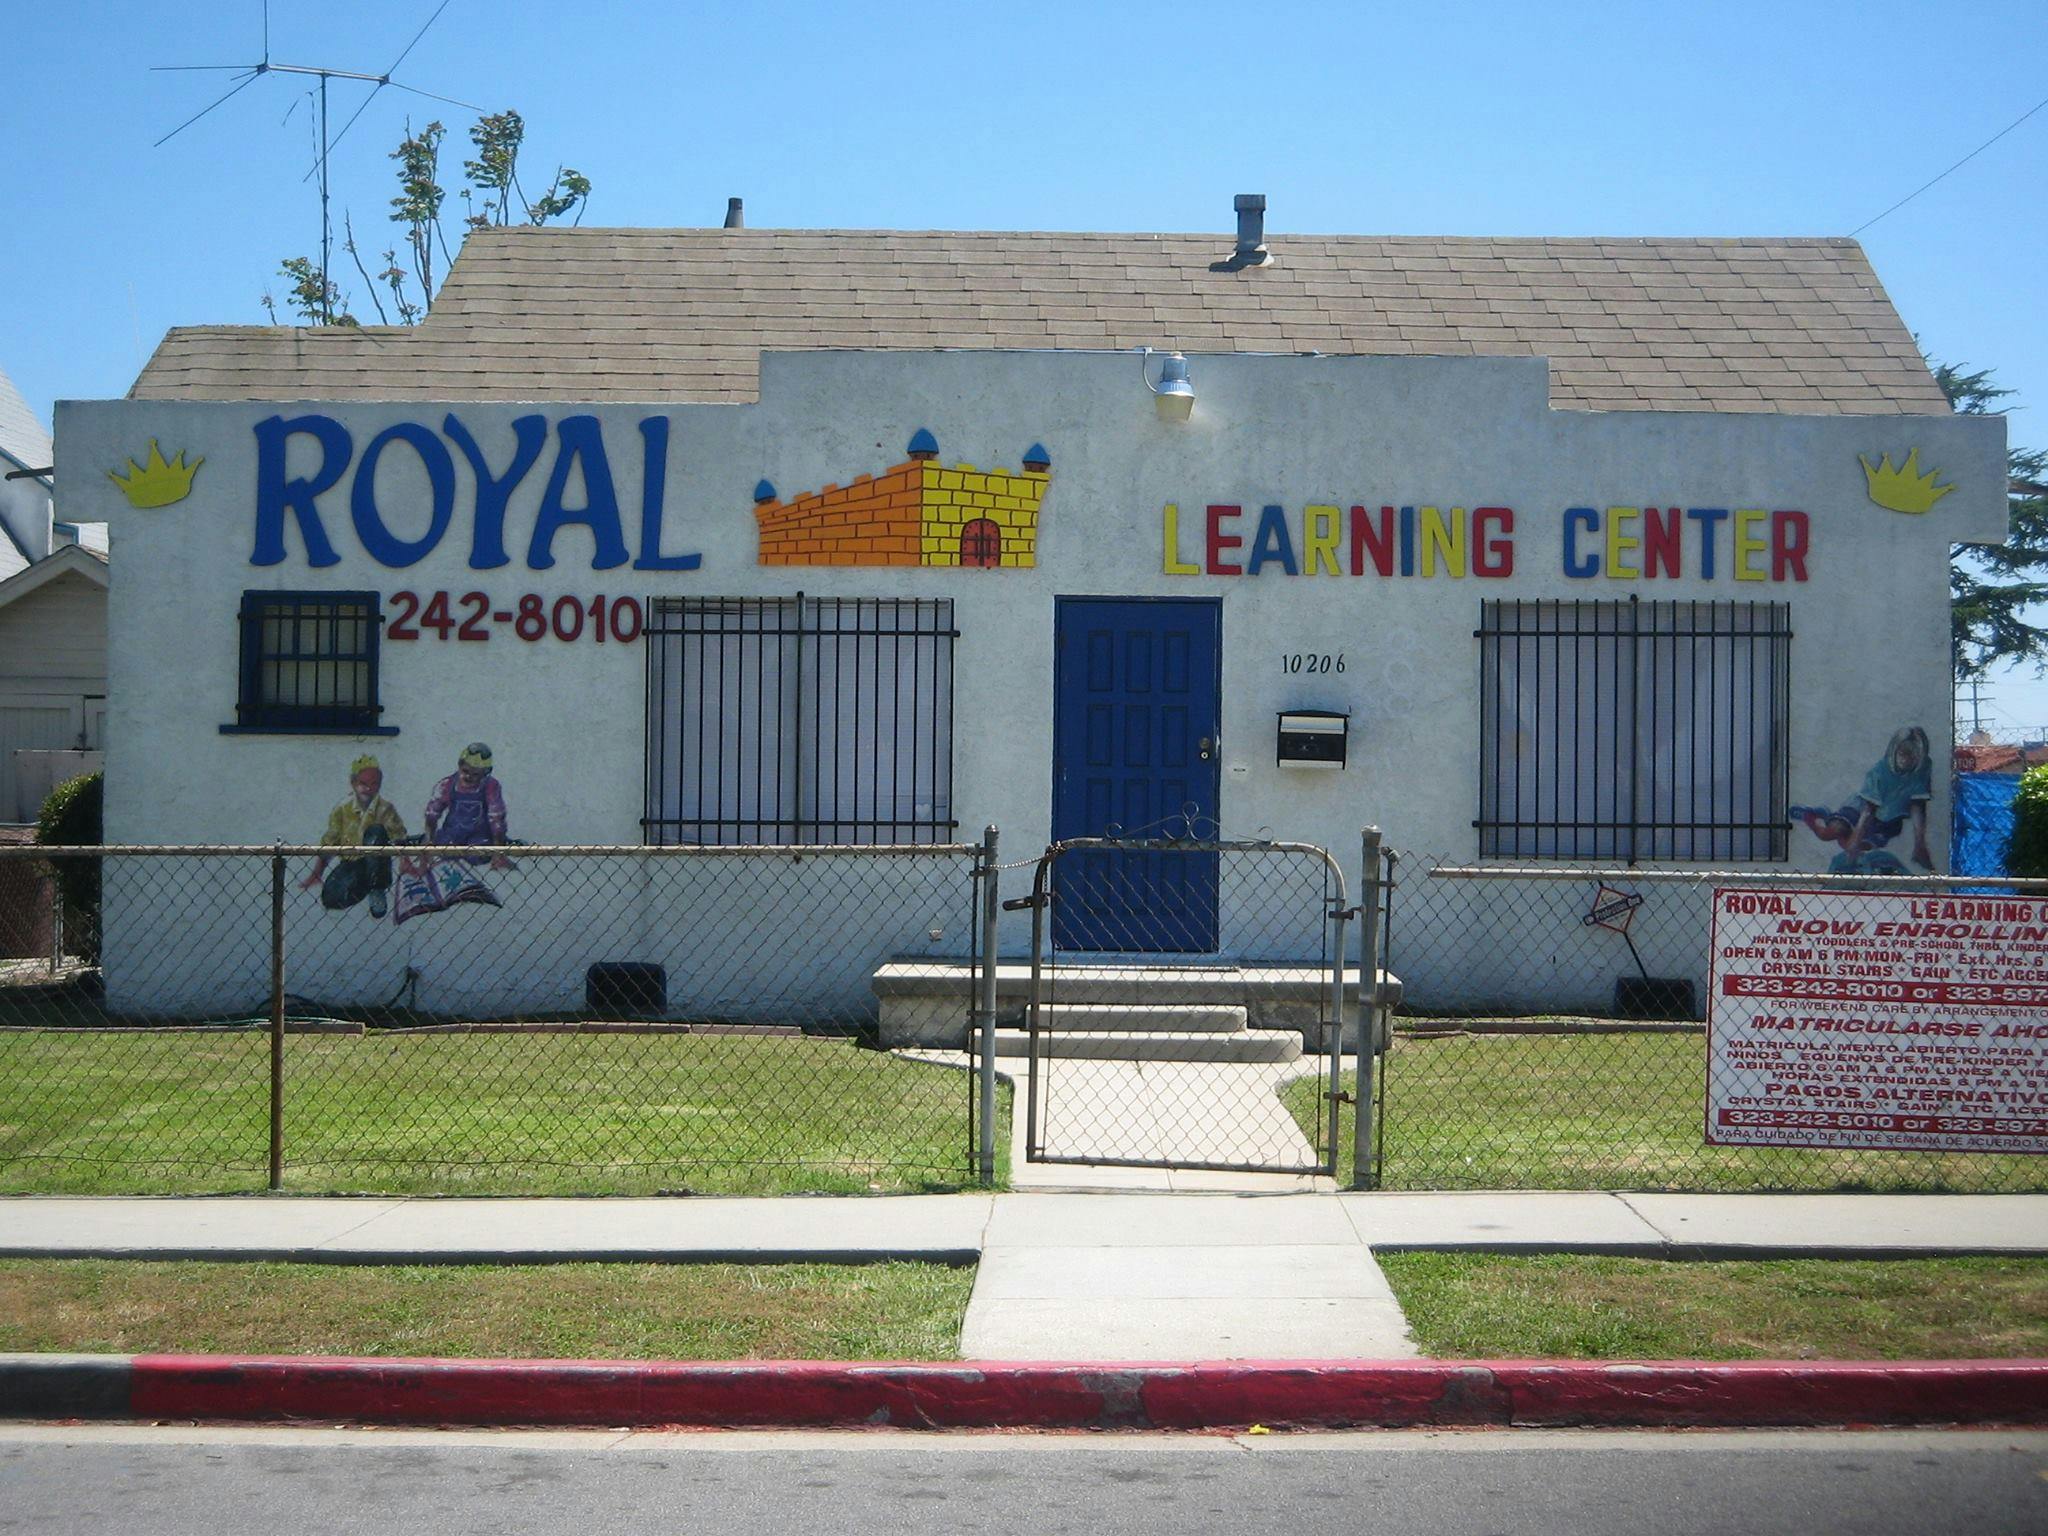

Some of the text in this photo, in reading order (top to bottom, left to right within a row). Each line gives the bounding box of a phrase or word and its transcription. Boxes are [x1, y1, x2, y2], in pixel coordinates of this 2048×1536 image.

[249, 413, 702, 570] ROYAL
[1163, 504, 1810, 582] LEARNING CENTER
[387, 590, 643, 643] 242-8010
[1282, 653, 1346, 674] 10206
[1726, 895, 1797, 915] ROYAL
[1910, 900, 2032, 922] LEARNING
[1776, 919, 1864, 935] NOW
[1752, 935, 1802, 945] INFANTS
[1815, 937, 1875, 947] TODDLERS
[1892, 939, 1966, 950] PRE-SCHOOL
[1723, 946, 1765, 959] OPEN
[1771, 948, 1781, 959] 6
[1786, 948, 1812, 960] AM
[1818, 949, 1828, 961] 6
[1834, 949, 1859, 962] PM
[2034, 956, 2044, 967] 6
[1761, 962, 1831, 975] CRYSTAL
[1836, 964, 1893, 977] STAIRS
[1911, 966, 1950, 978] GAIN
[2003, 969, 2048, 982] ACCE
[1736, 977, 1904, 998] 323-242-8010
[1912, 987, 1939, 999] or
[1770, 1000, 1797, 1009] FOR
[1802, 1001, 1868, 1012] WEEKEND
[1872, 1004, 1908, 1014] CARE
[1912, 1005, 1929, 1014] BY
[1751, 1015, 1983, 1037] MATRICULARSE
[1904, 1044, 1980, 1055] ABIERTO
[1987, 1047, 2034, 1057] PARA
[1734, 1061, 1810, 1071] ABIERTO
[1834, 1064, 1860, 1073] AM
[1867, 1065, 1878, 1074] A
[1903, 1065, 1929, 1075] PM
[1935, 1067, 1993, 1076] LUNES
[2001, 1068, 2011, 1077] A
[1892, 1055, 1915, 1064] DE
[1921, 1055, 2027, 1067] PRE-KINDER
[1771, 1071, 1834, 1082] HORAS
[1840, 1074, 1952, 1086] EXTENDIDAS
[1976, 1078, 2002, 1088] PM
[2009, 1079, 2019, 1088] A
[1765, 1083, 1861, 1099] PAGOS
[1728, 1096, 1807, 1107] CRYSTAL
[1814, 1099, 1877, 1109] STAIRS
[1898, 1101, 1941, 1111] GAIN
[1728, 1110, 2048, 1133] 323-242-8010 or 323-597-
[1716, 1129, 1751, 1139] PARA
[1755, 1130, 1815, 1140] CUIDADO
[1819, 1132, 1837, 1141] DE
[1865, 1133, 1882, 1143] DE
[1886, 1134, 1941, 1145] SEMANA
[1945, 1136, 1963, 1146] DE
[1967, 1137, 2031, 1147] ACUERDO
